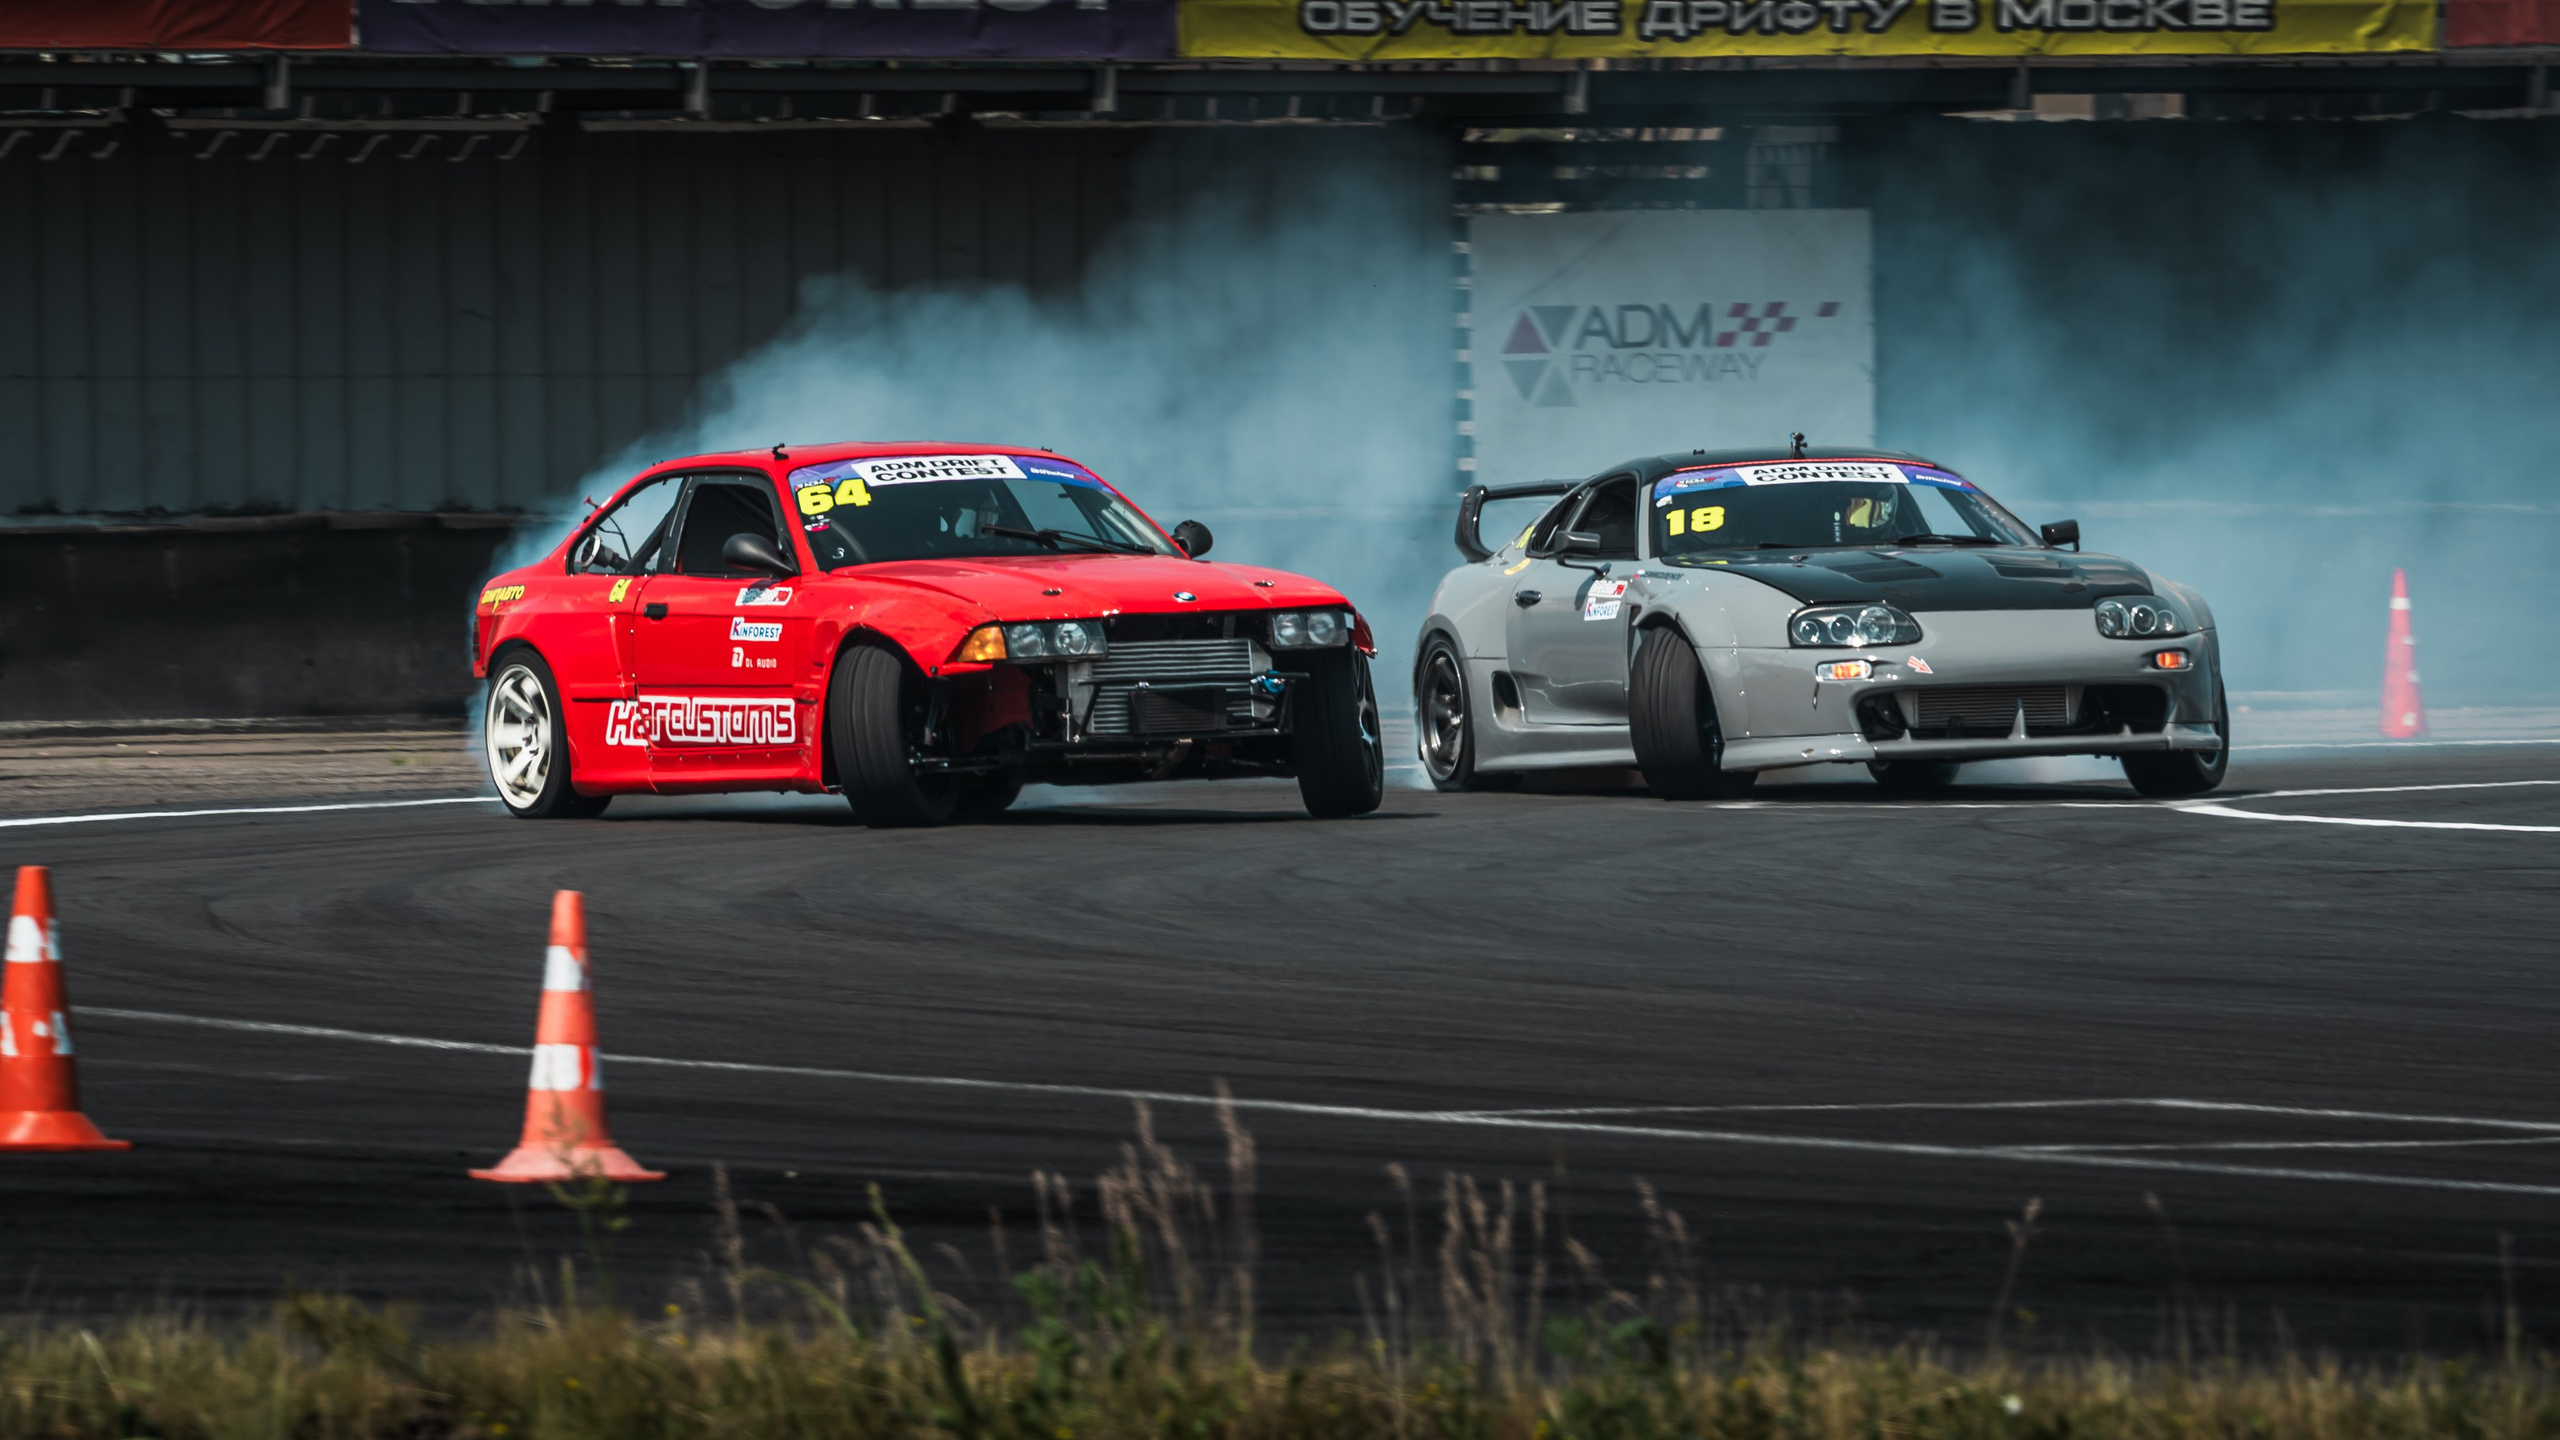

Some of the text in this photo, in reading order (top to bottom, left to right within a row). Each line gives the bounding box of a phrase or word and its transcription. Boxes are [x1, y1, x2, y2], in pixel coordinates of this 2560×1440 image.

[1303, 0, 2273, 38] ОБУЧЕНИЕ ДРИФТУ В МОСКВЕ
[1574, 302, 1713, 349] ADM
[1569, 353, 1768, 384] RACEWAY
[870, 458, 1000, 473] ADM DRIFT
[876, 466, 1009, 482] CONTEST
[1753, 464, 1886, 475] ADM DRIFT
[1756, 470, 1893, 482] CONTEST
[797, 479, 873, 515] 64
[1665, 505, 1726, 536] 18
